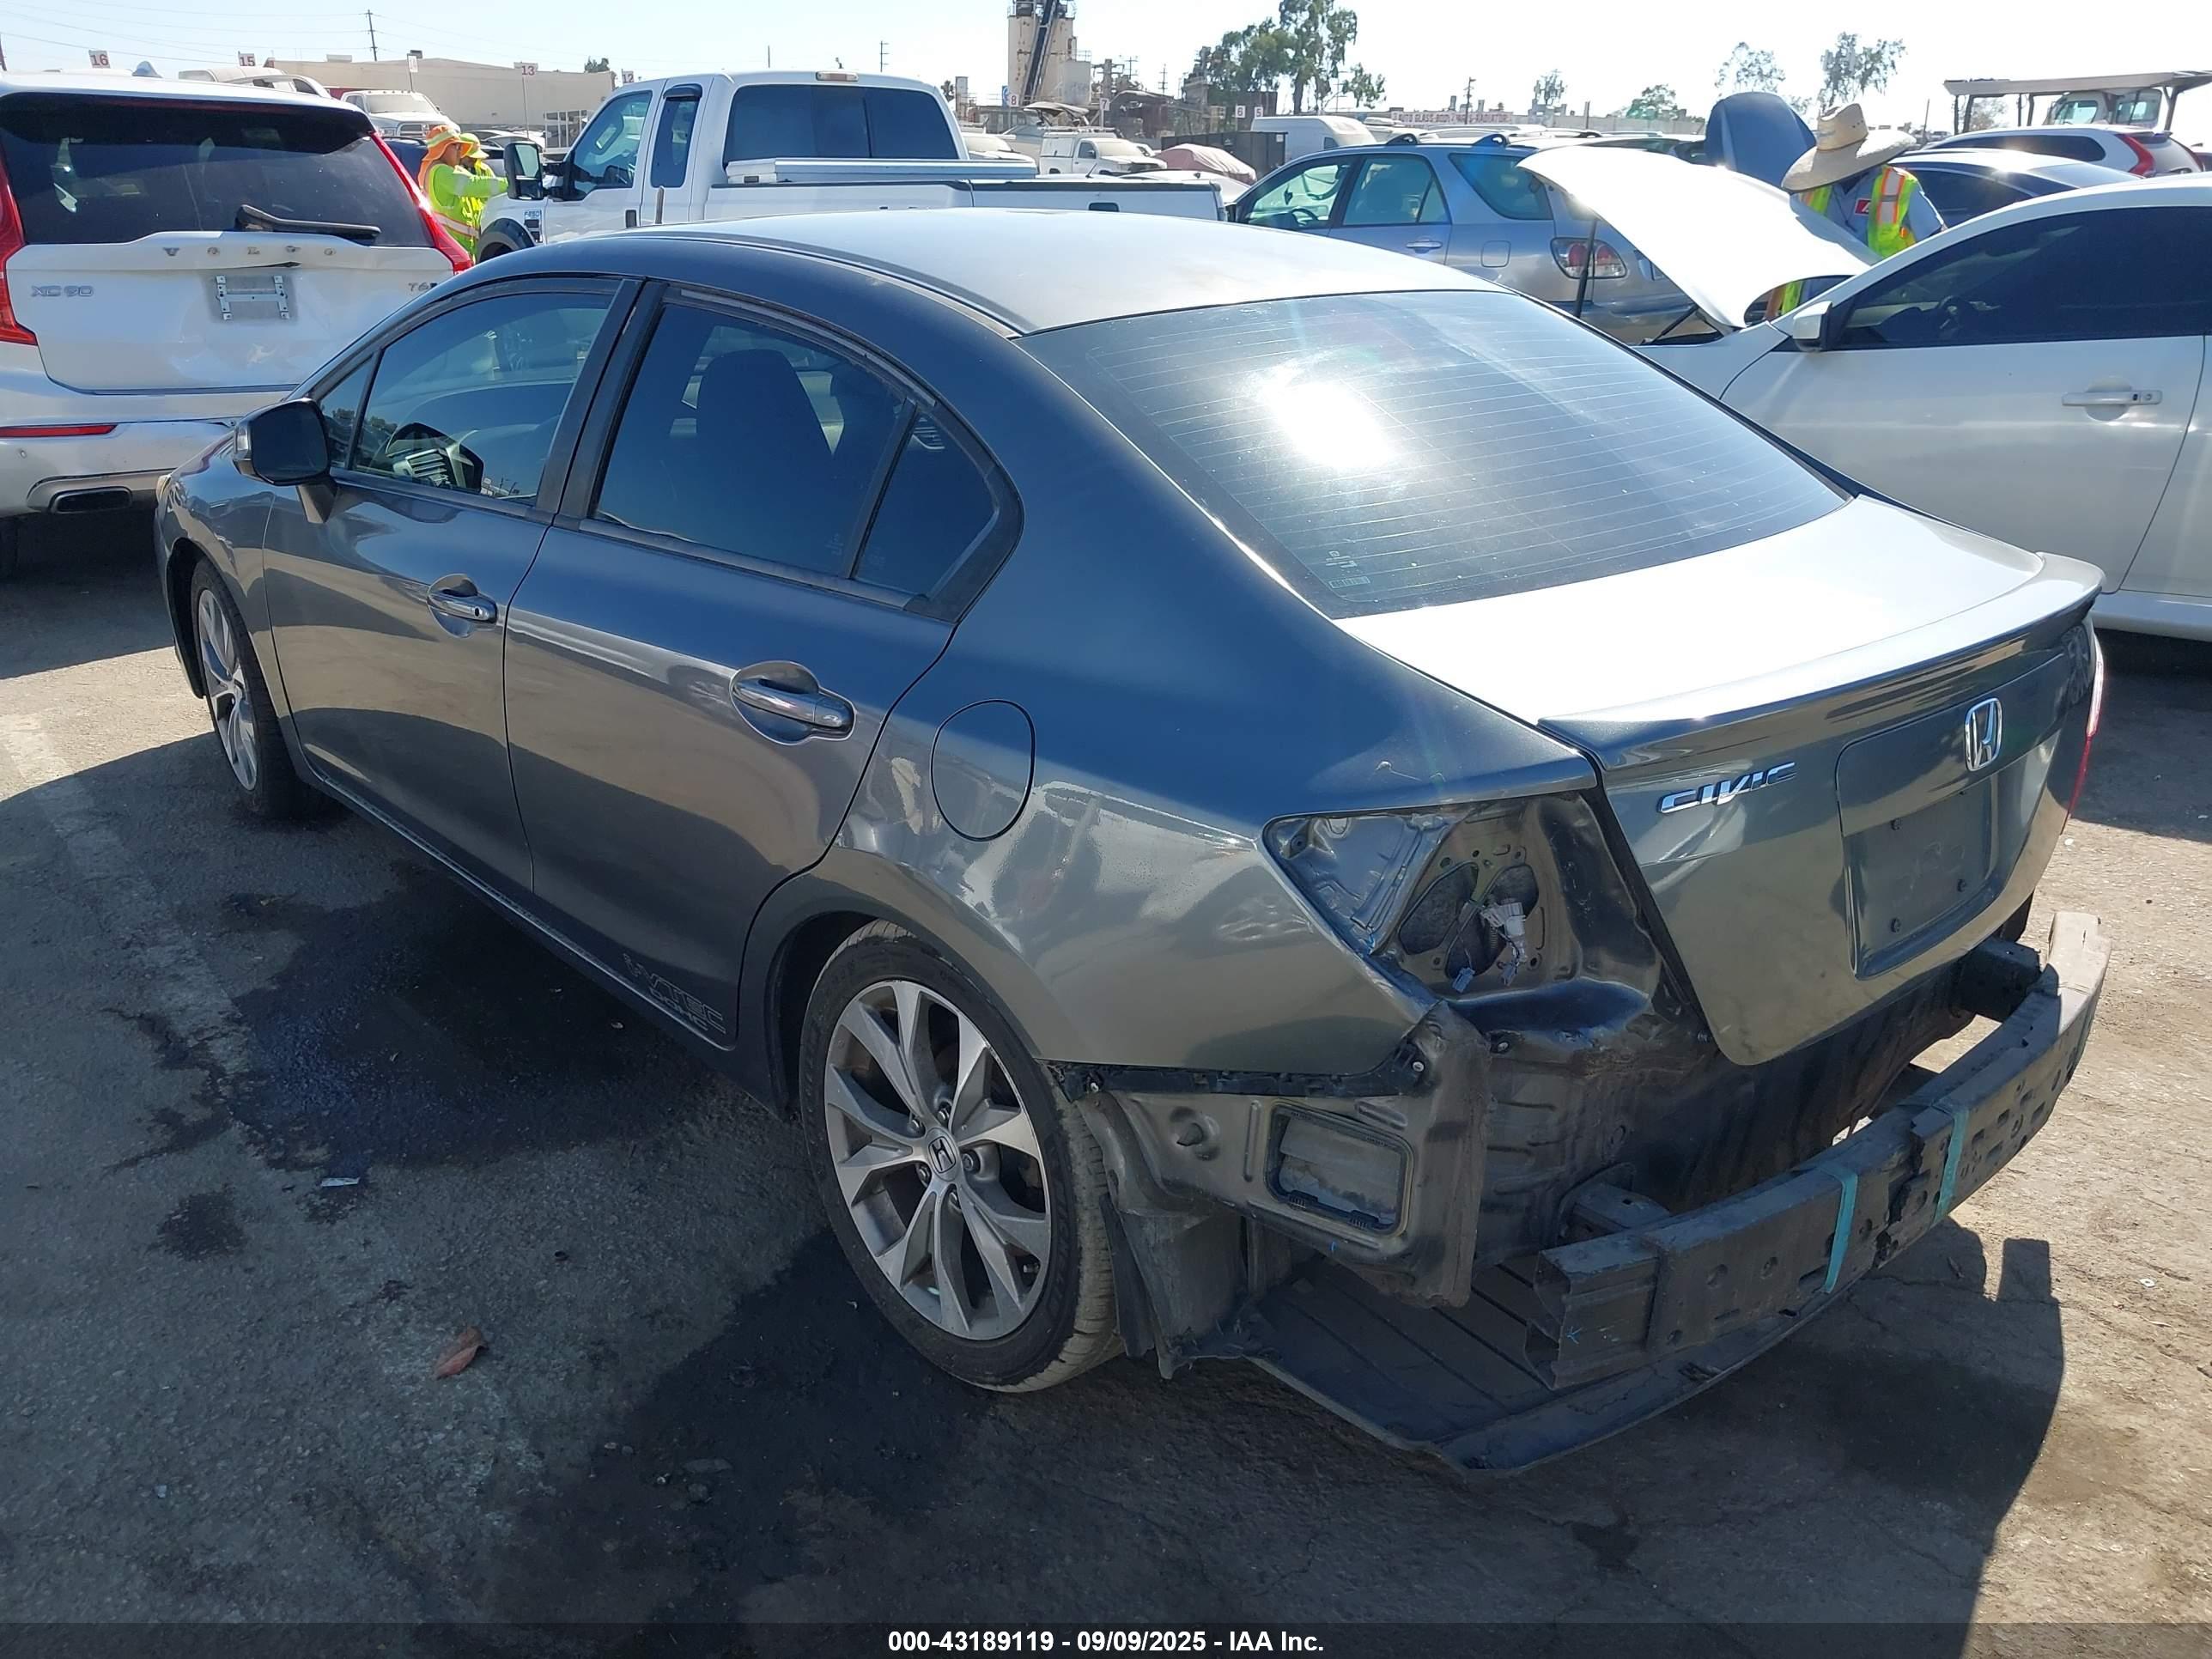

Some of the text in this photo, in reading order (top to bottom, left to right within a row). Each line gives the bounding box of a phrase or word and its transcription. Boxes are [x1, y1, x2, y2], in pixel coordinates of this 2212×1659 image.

[90, 53, 109, 66] 16
[240, 56, 256, 66] 15
[521, 65, 535, 76] 13
[623, 74, 634, 83] 12
[1011, 94, 1017, 105] 8
[1102, 98, 1108, 109] 7
[1237, 107, 1243, 117] 6
[1256, 108, 1262, 117] 5
[163, 246, 337, 257] VOLVO
[1656, 762, 1796, 814] CIVIC
